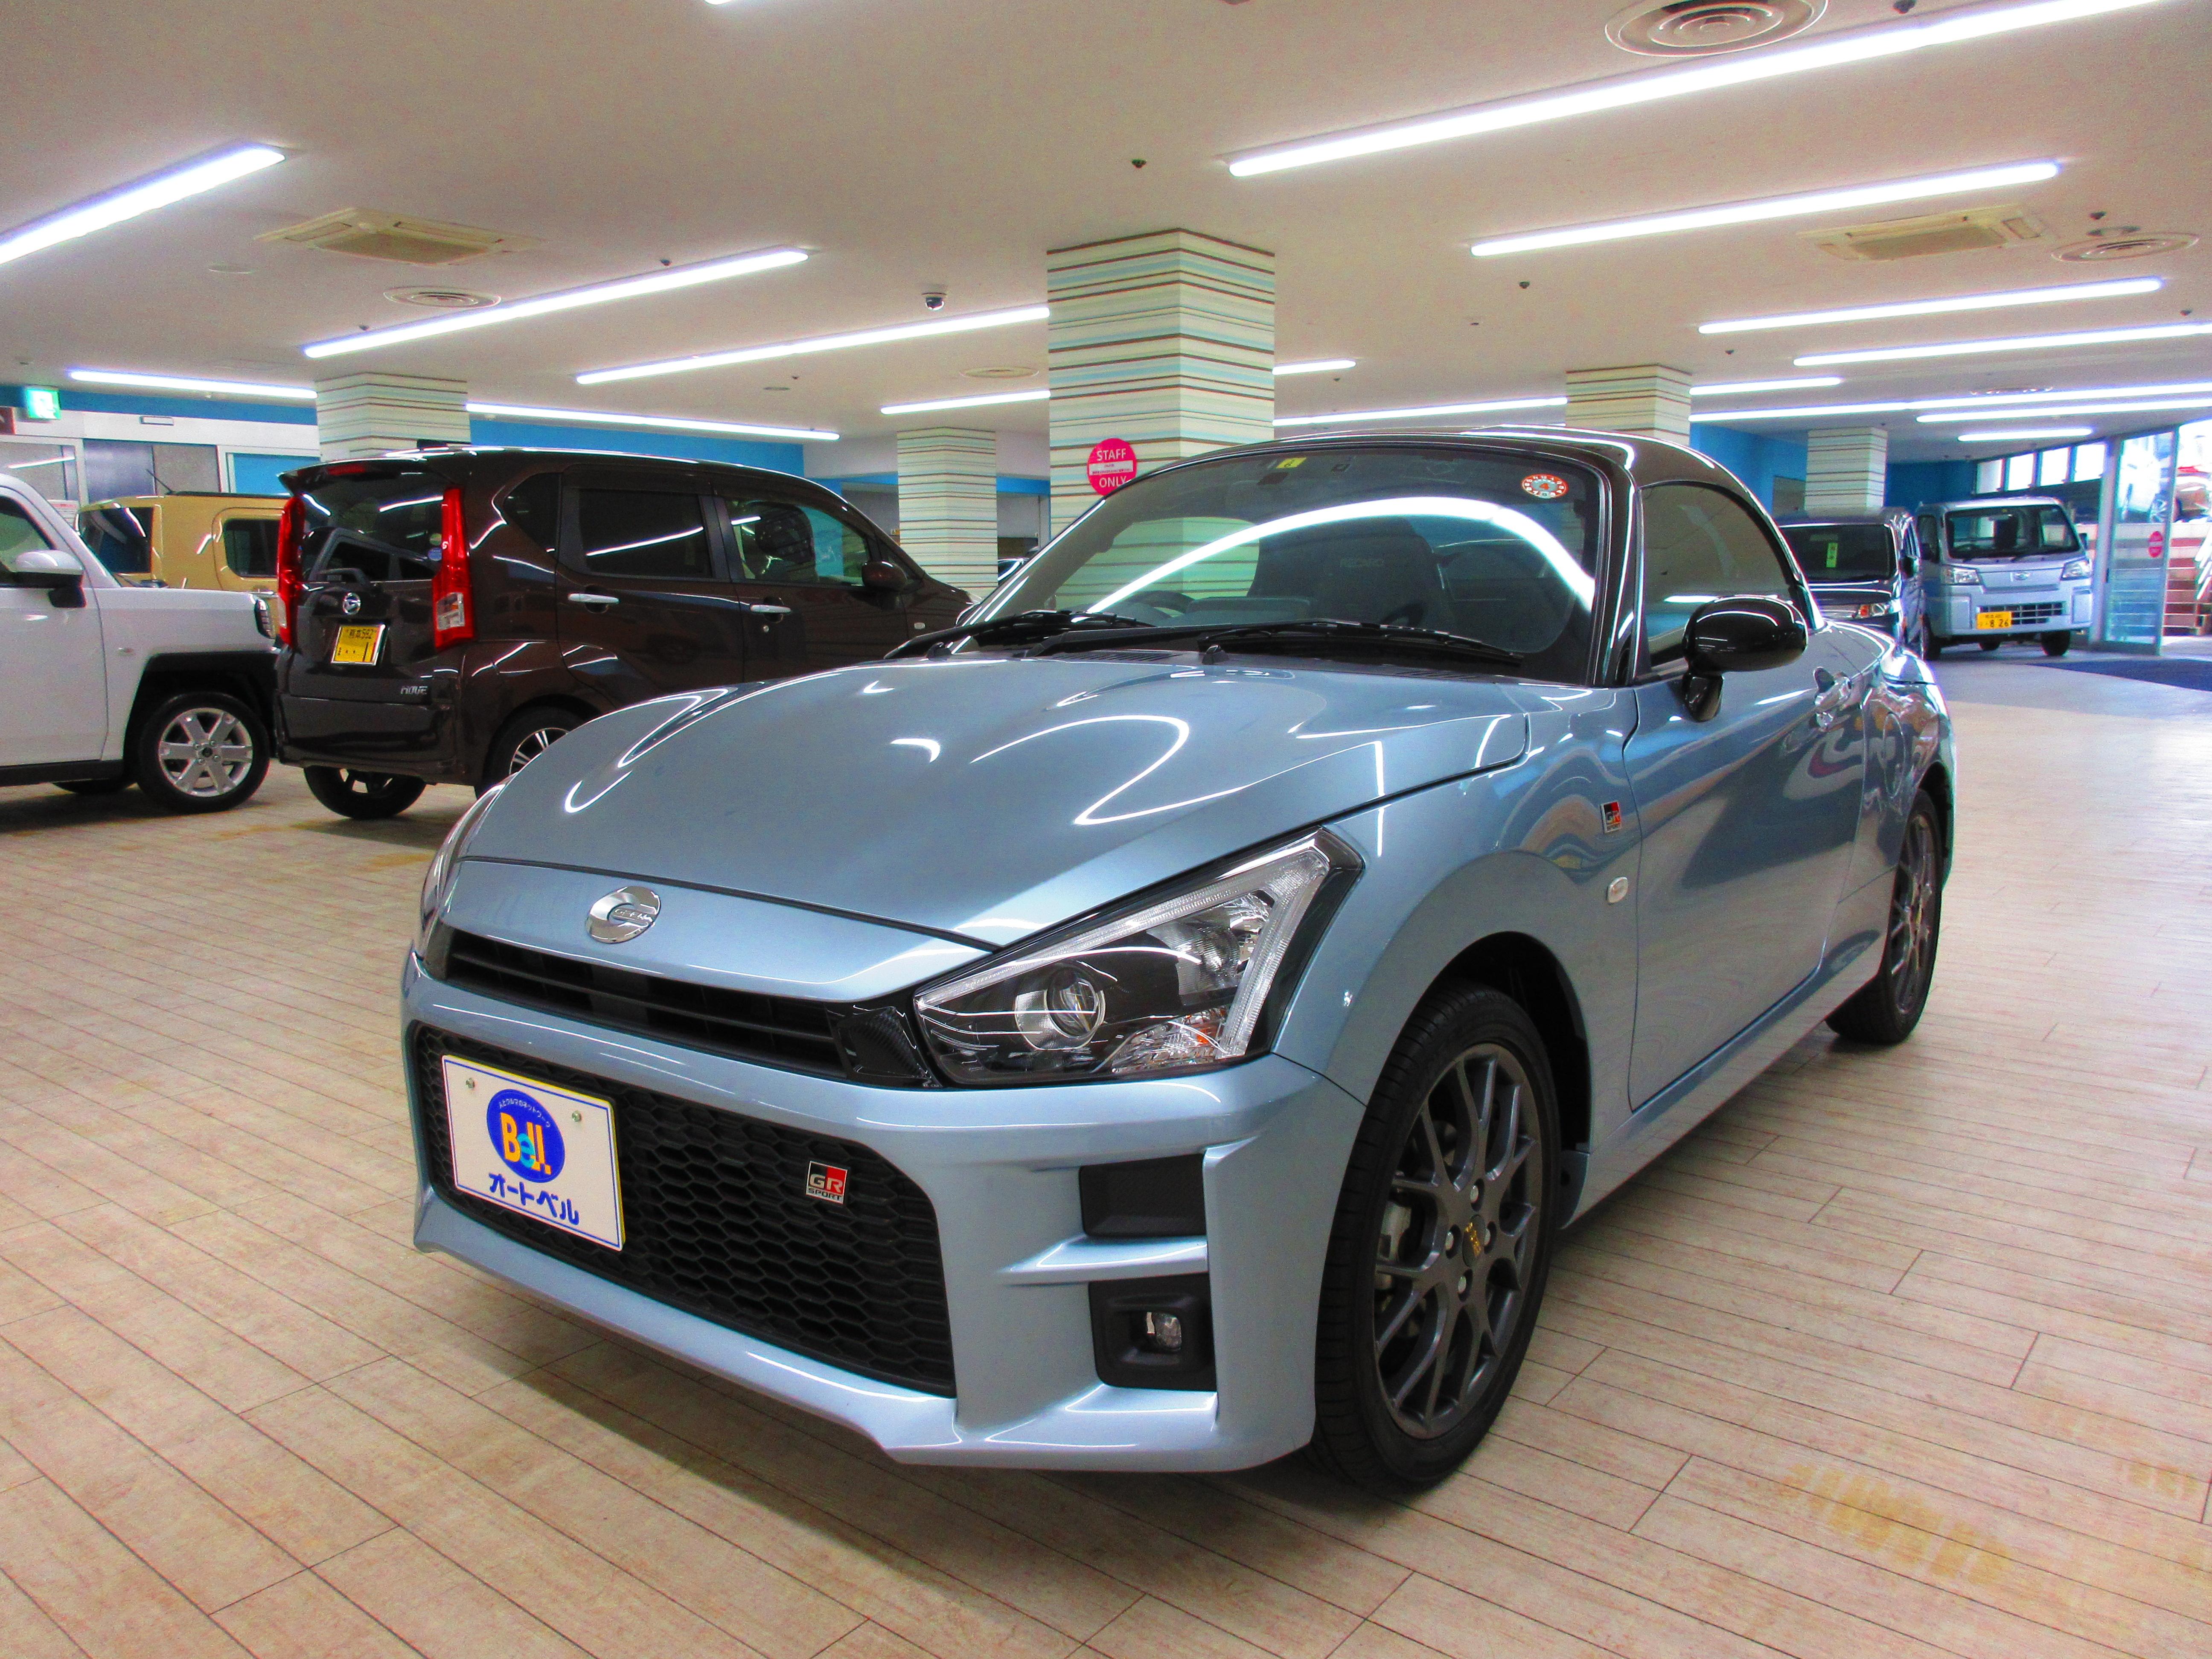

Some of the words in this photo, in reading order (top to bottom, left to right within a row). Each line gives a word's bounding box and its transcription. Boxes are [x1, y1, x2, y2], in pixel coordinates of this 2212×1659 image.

[1097, 448, 1126, 461] STAFF
[1099, 476, 1126, 488] ONLY
[809, 1173, 843, 1193] GR
[489, 1173, 579, 1225] オートベル
[808, 1187, 842, 1200] SPORT
